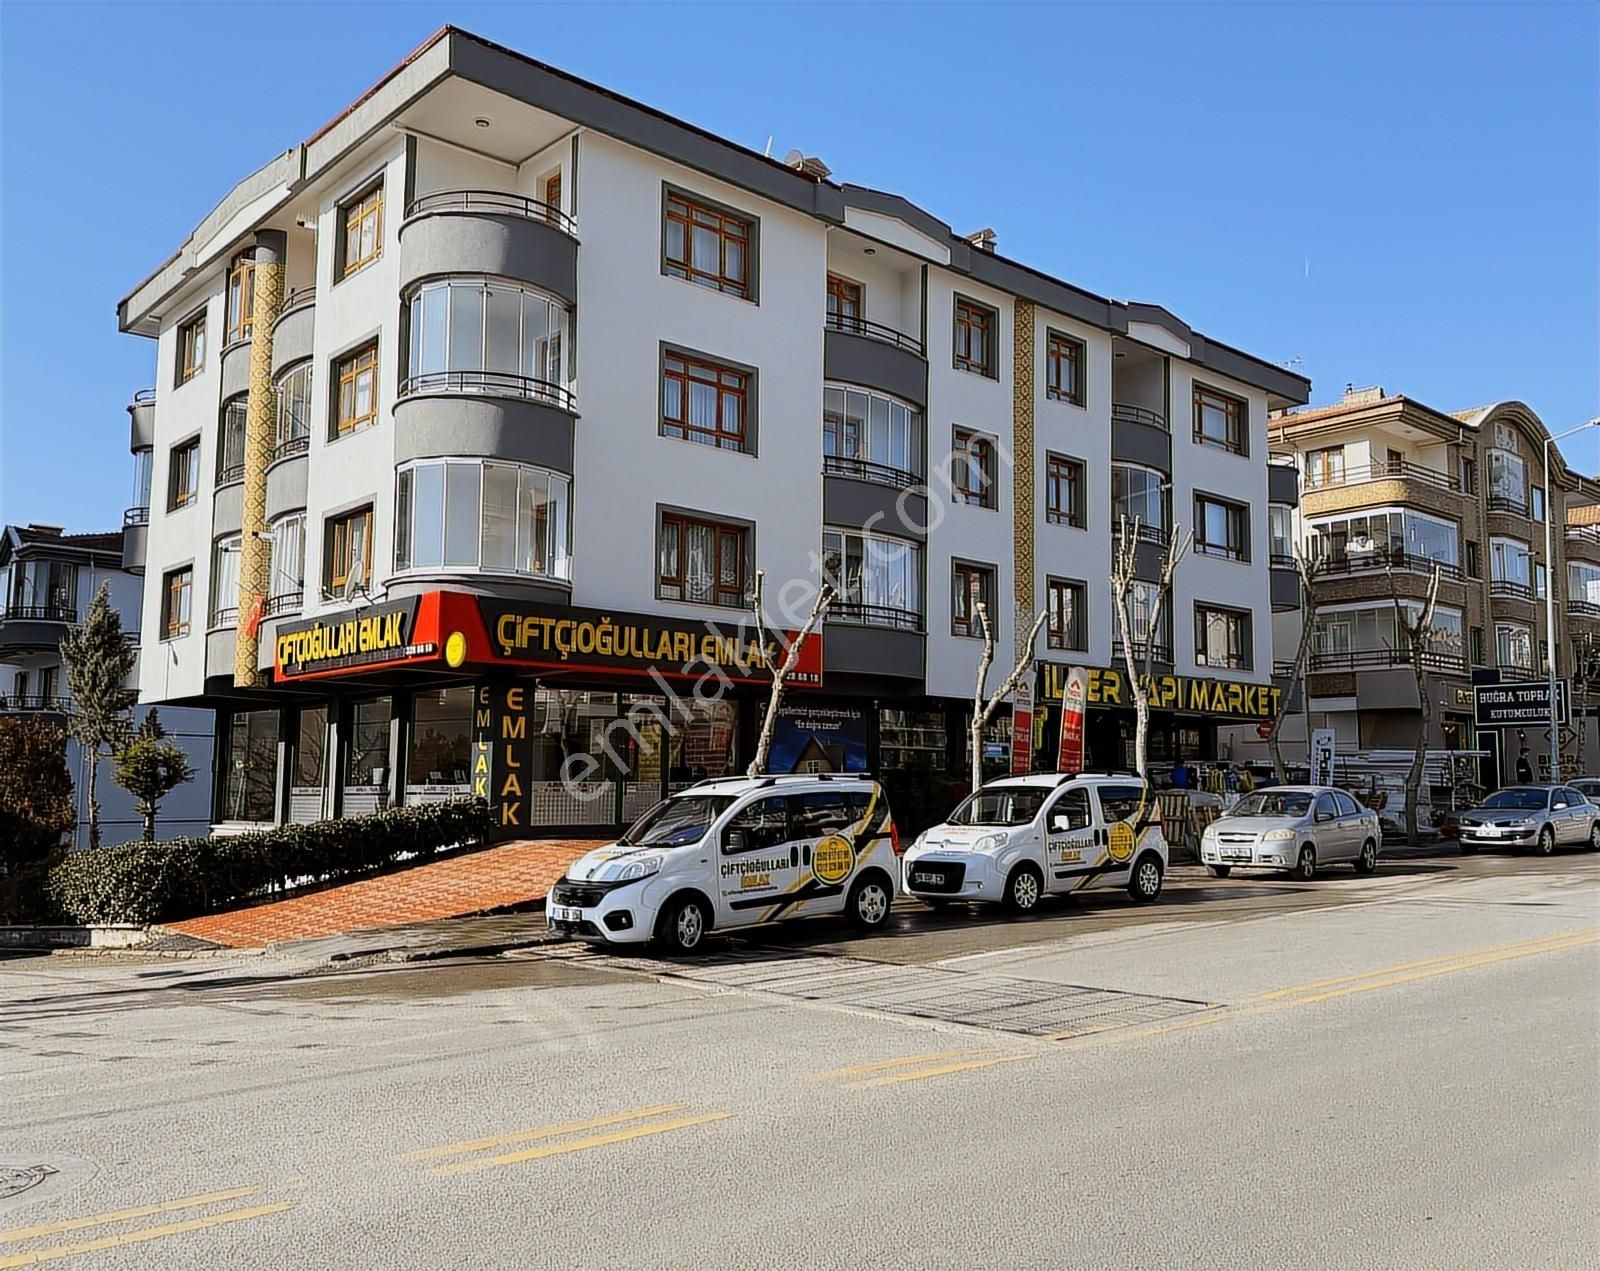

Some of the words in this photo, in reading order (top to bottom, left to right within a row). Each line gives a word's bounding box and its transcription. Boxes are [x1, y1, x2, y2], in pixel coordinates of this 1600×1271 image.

[358, 612, 404, 652] EMLAK
[700, 634, 776, 669] EMLAK
[1044, 663, 1122, 705] İLER
[1190, 679, 1282, 717] MARKET
[1479, 690, 1515, 704] BUĞRA
[475, 686, 491, 798] EMLAK
[501, 687, 526, 826] EMLAK
